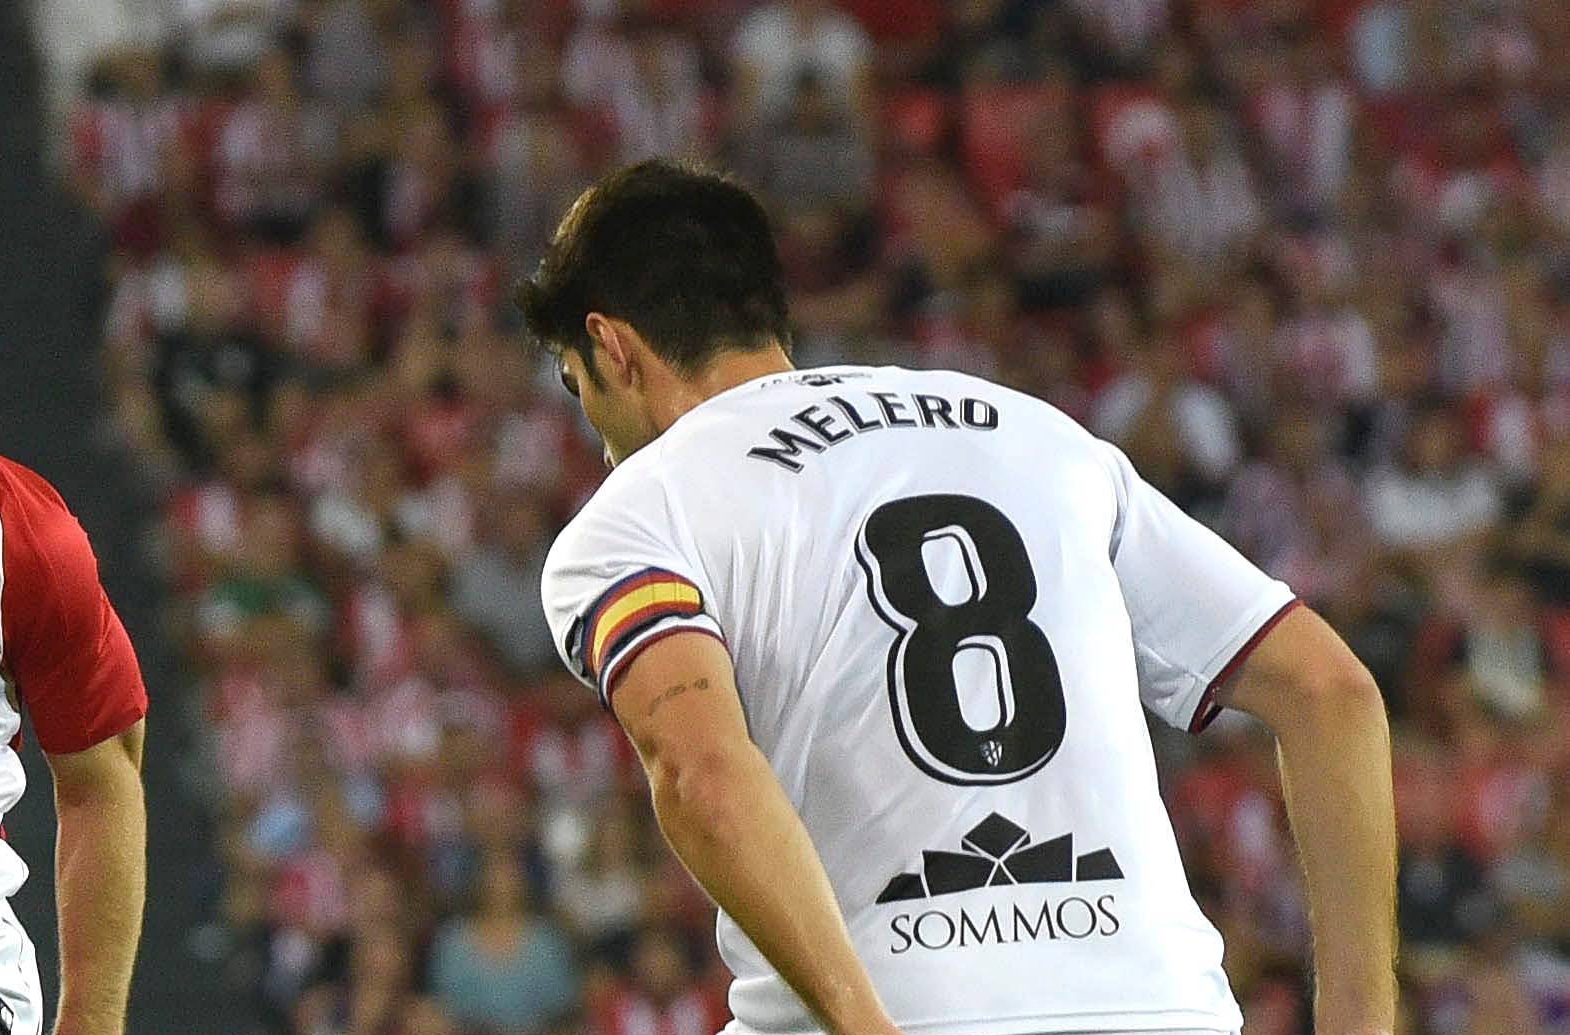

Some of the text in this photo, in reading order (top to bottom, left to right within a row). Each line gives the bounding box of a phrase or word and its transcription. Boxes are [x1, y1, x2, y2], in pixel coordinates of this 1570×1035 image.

[747, 392, 1000, 473] MELERO
[854, 493, 1067, 787] 8
[890, 895, 1121, 954] SOMMOS
